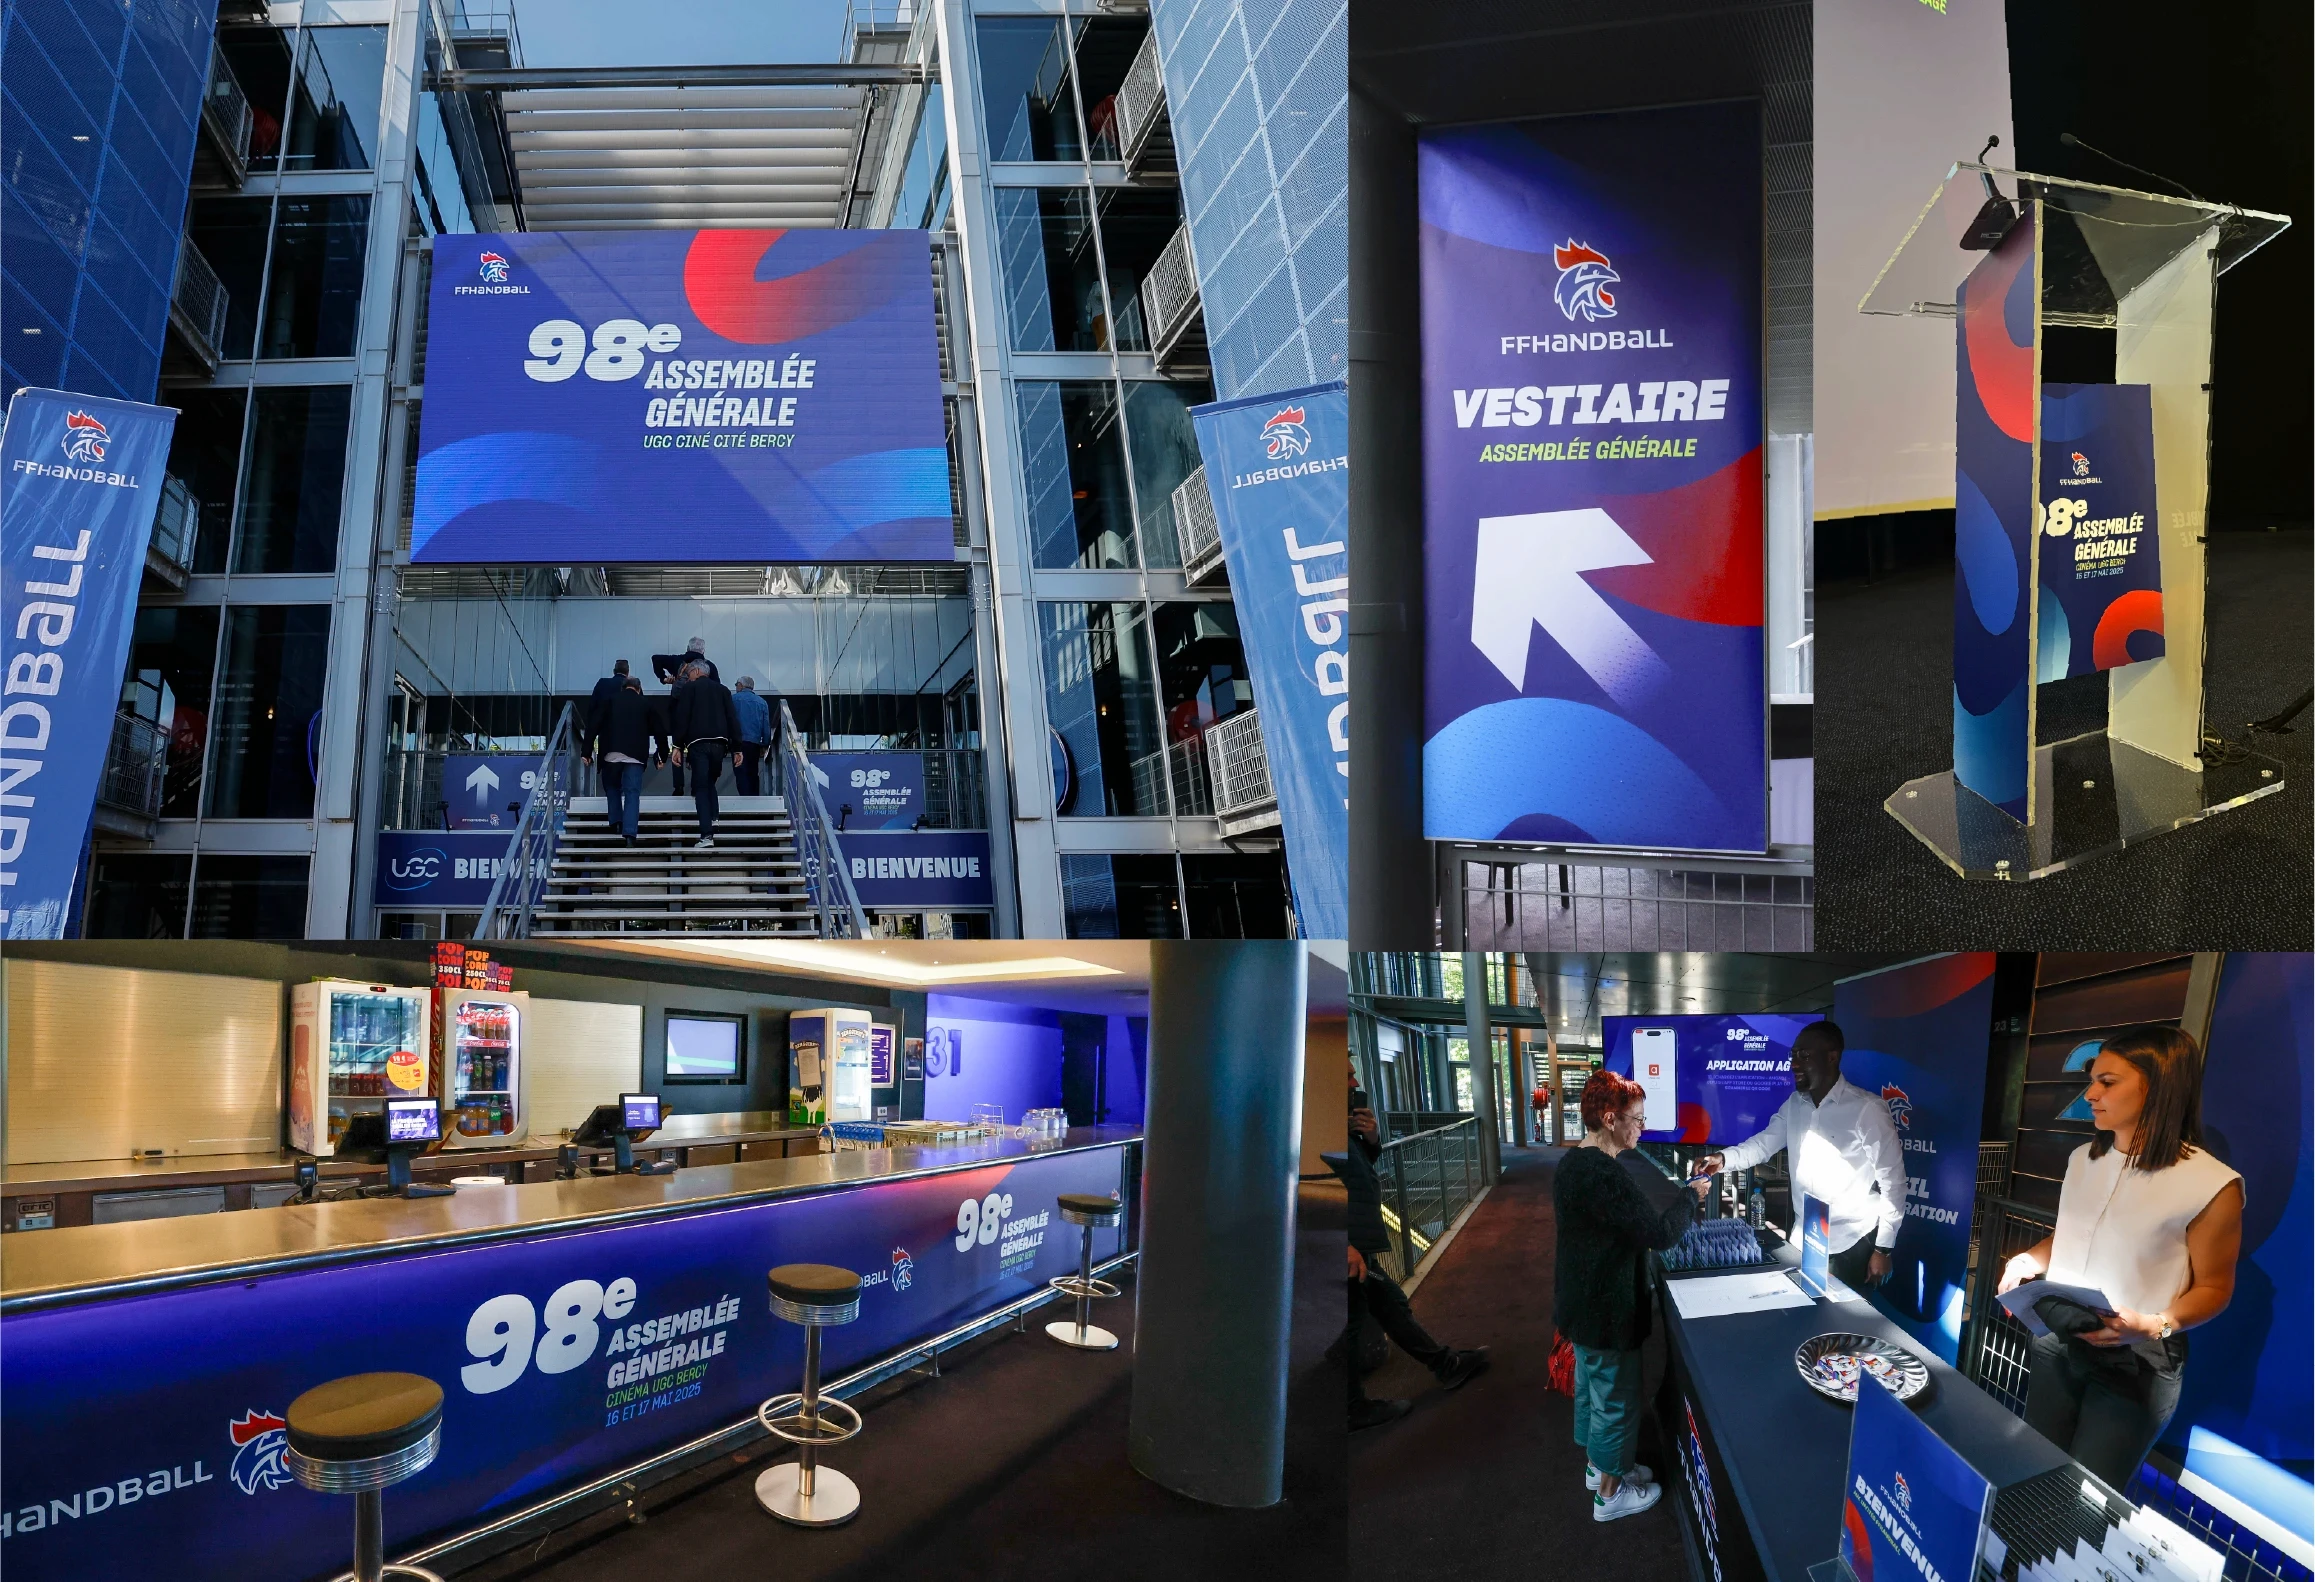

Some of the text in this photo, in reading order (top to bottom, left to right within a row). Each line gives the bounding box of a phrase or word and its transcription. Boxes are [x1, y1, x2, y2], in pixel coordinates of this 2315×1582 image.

[644, 353, 816, 389] ASSEMBLÉE
[645, 391, 797, 427] GÉNÉRALE
[1453, 379, 1730, 428] VESTIAIRE
[643, 431, 795, 448] UGC CINÉ CITÉ BERCY
[1480, 435, 1697, 462] ASSEMBLÉE GÉNÉRALE
[2073, 512, 2144, 539] ASSEMBLÉE
[2075, 536, 2137, 561] GÉNÉRALE
[862, 787, 912, 795] ASSEMBLÉE
[863, 796, 907, 804] GÉNÉRALE
[391, 857, 440, 878] UGC
[852, 857, 981, 878] BIENVENUE
[437, 942, 465, 955] POP
[437, 955, 464, 966] CORN
[465, 950, 489, 961] POP
[926, 1026, 962, 1077] 31
[1706, 1060, 1791, 1071] APPLICATION AG
[1001, 1209, 1049, 1239] ASSEMBLÉE
[1001, 1232, 1044, 1258] GÉNÉRALE
[606, 1294, 741, 1357] ASSEMBLÉE
[607, 1330, 727, 1389] GÉNÉRALE
[606, 1363, 709, 1408] CINÉMA UGC BERCY
[605, 1381, 702, 1427] 16 ET 17 MAI 2025
